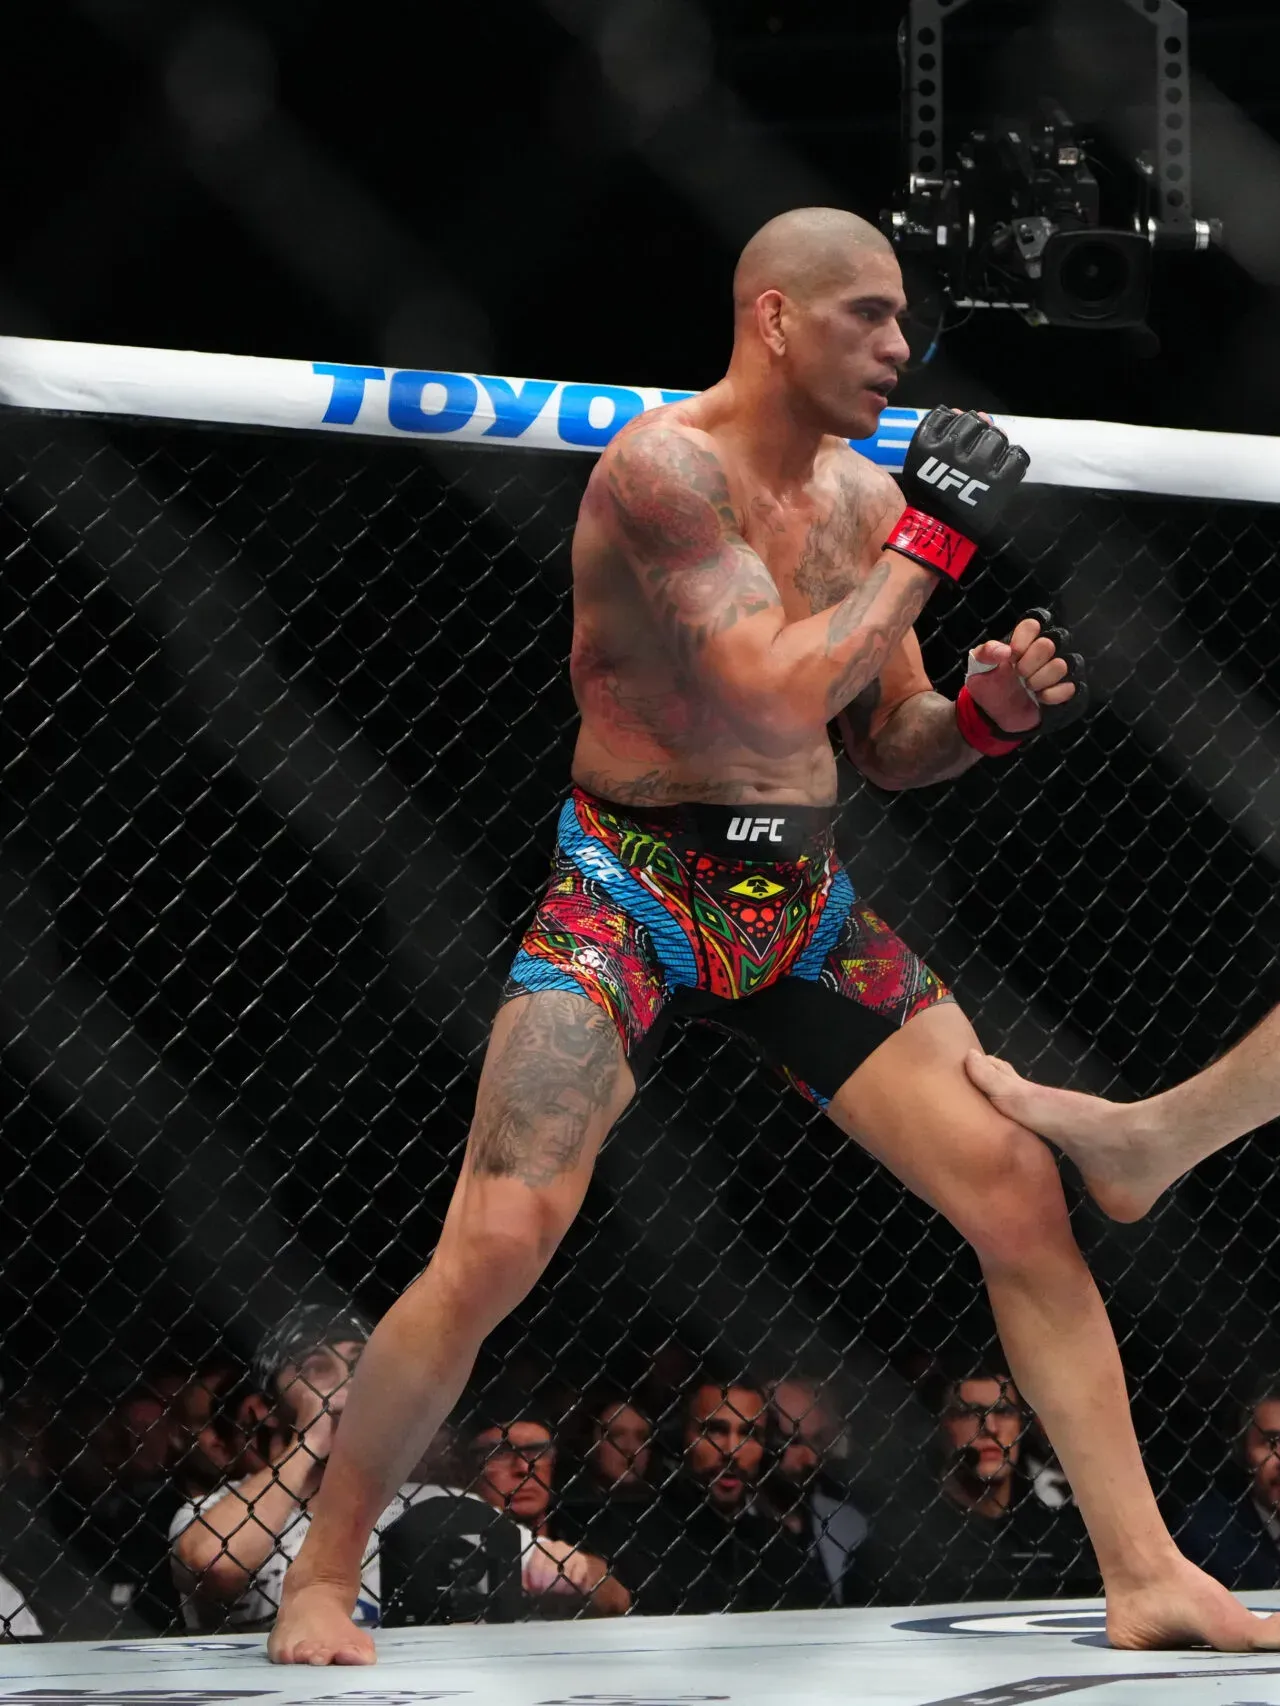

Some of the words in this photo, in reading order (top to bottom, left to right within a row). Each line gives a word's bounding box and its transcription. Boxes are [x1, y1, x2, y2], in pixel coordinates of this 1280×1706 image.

[312, 363, 644, 447] TOYO
[917, 456, 991, 506] UFC
[727, 817, 785, 842] UFC
